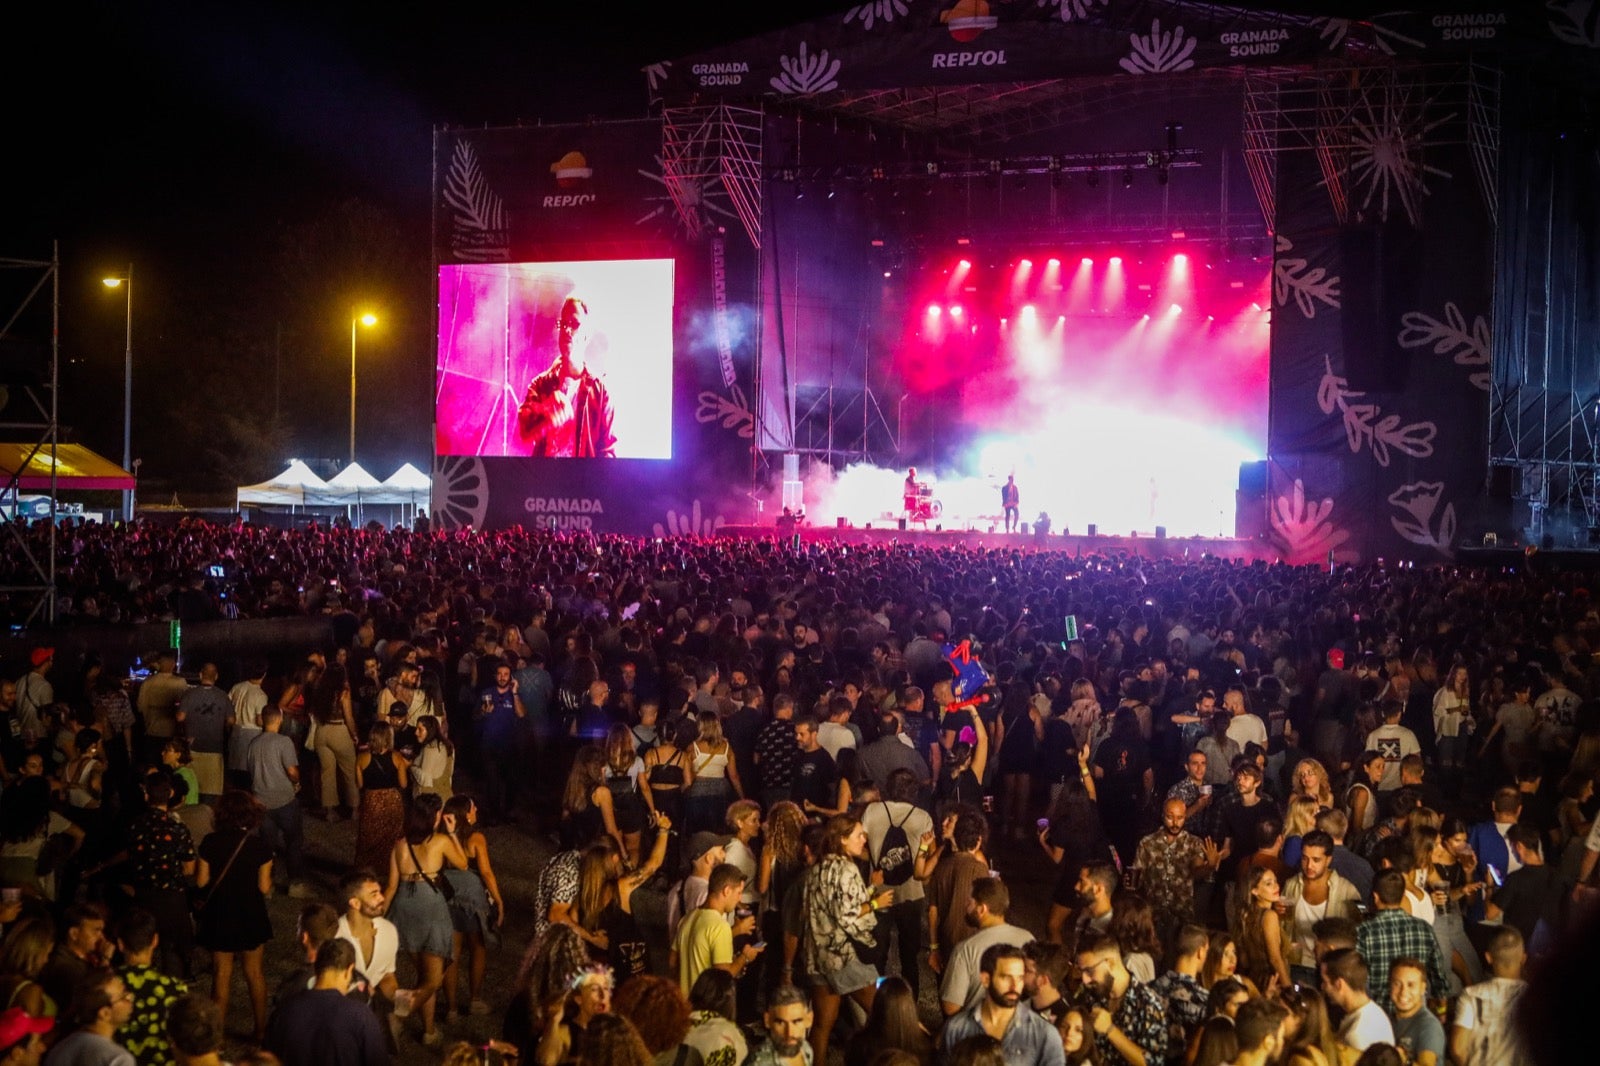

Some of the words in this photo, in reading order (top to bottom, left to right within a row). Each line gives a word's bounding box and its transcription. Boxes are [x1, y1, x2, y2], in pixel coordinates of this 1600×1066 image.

[1432, 13, 1507, 27] GRANADA
[1220, 28, 1289, 45] GRANADA
[1442, 27, 1496, 40] SOUND
[1230, 42, 1280, 57] SOUND
[932, 49, 1007, 68] REPSOL
[692, 61, 750, 75] GRANADA
[700, 74, 742, 86] SOUND
[524, 497, 603, 513] GRANADA
[536, 514, 593, 530] SOUND
